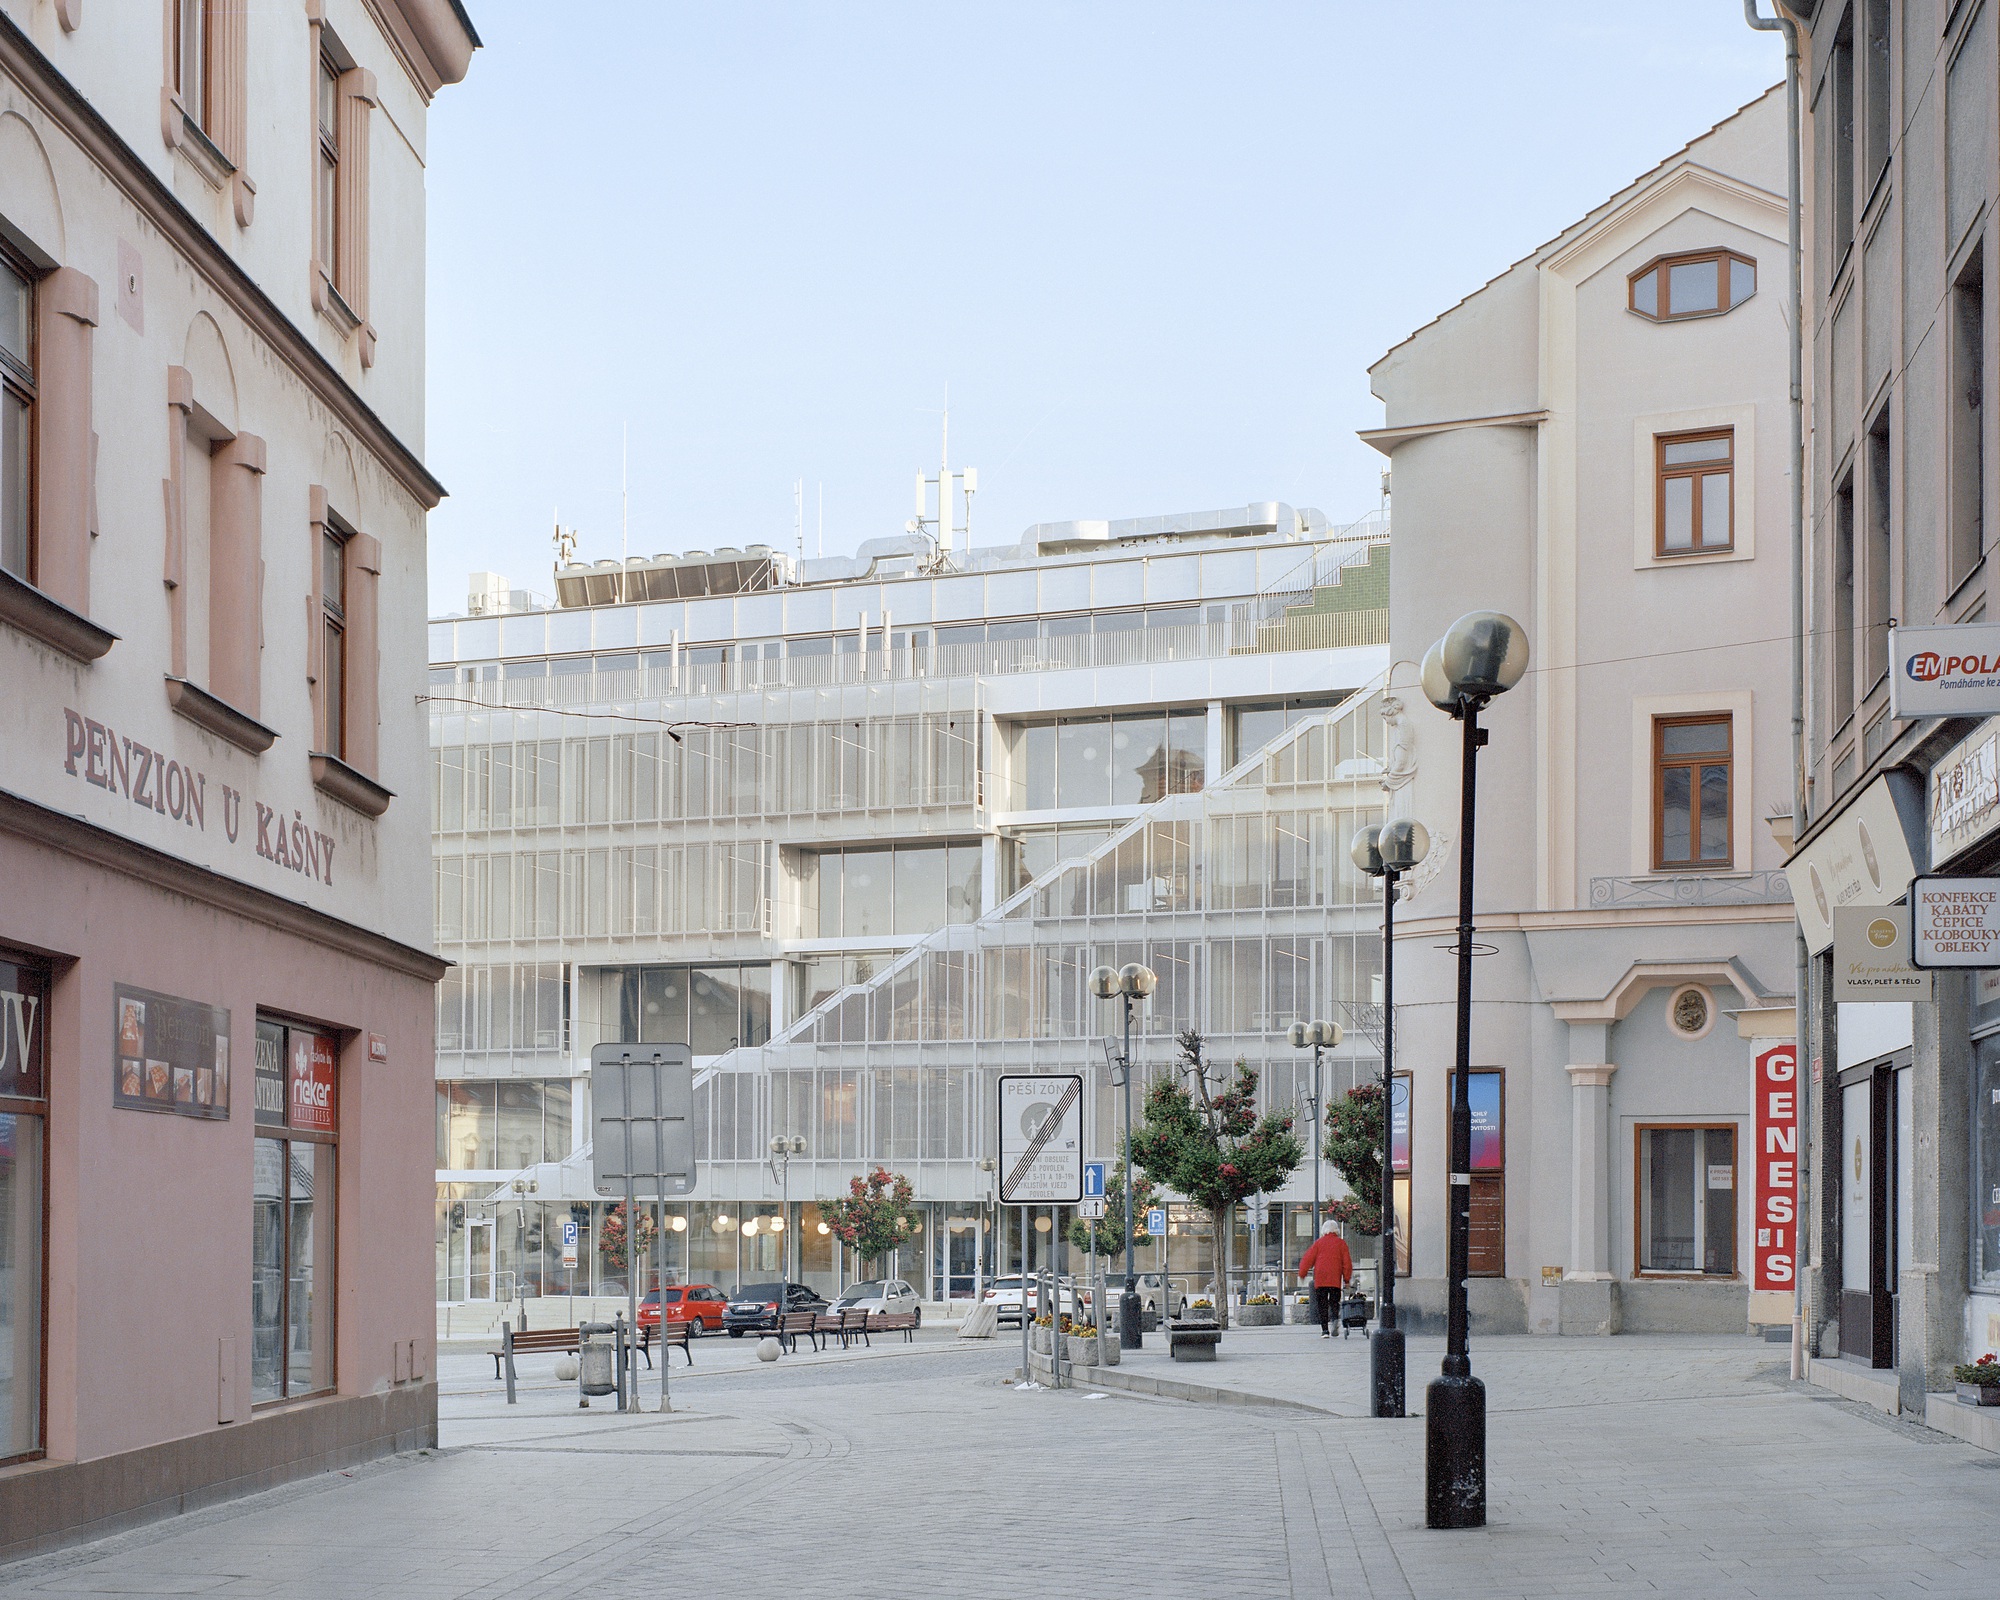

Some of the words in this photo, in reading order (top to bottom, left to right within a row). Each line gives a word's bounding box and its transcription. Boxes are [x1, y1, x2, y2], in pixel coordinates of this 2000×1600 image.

[1940, 677, 1985, 690] Pomáháme
[1986, 677, 1995, 688] ke
[63, 706, 206, 832] PENZION
[222, 784, 241, 844] U
[255, 801, 336, 887] KAŠNY
[1922, 892, 1997, 904] KONFEKCE
[1931, 903, 1989, 916] KABÁTY
[1932, 915, 1984, 928] ČEPICE
[1923, 929, 2000, 941] KLOBOUKY
[1934, 942, 1991, 953] OBLEKY
[1881, 963, 1915, 974] nádhern
[1874, 977, 1893, 985] PLEŤ
[1901, 977, 1921, 985] TĚLO
[293, 1070, 331, 1108] rieker
[1008, 1082, 1036, 1096] PĚŠÍ
[1044, 1155, 1070, 1163] OBSLUZE
[1039, 1164, 1065, 1172] POVOLEN
[1765, 1054, 1797, 1282] GENESIS
[1049, 1173, 1053, 1181] A
[1051, 1181, 1068, 1189] VJEZD
[1029, 1190, 1055, 1198] POVOLEN
[1151, 1213, 1162, 1228] P
[565, 1225, 575, 1239] P
